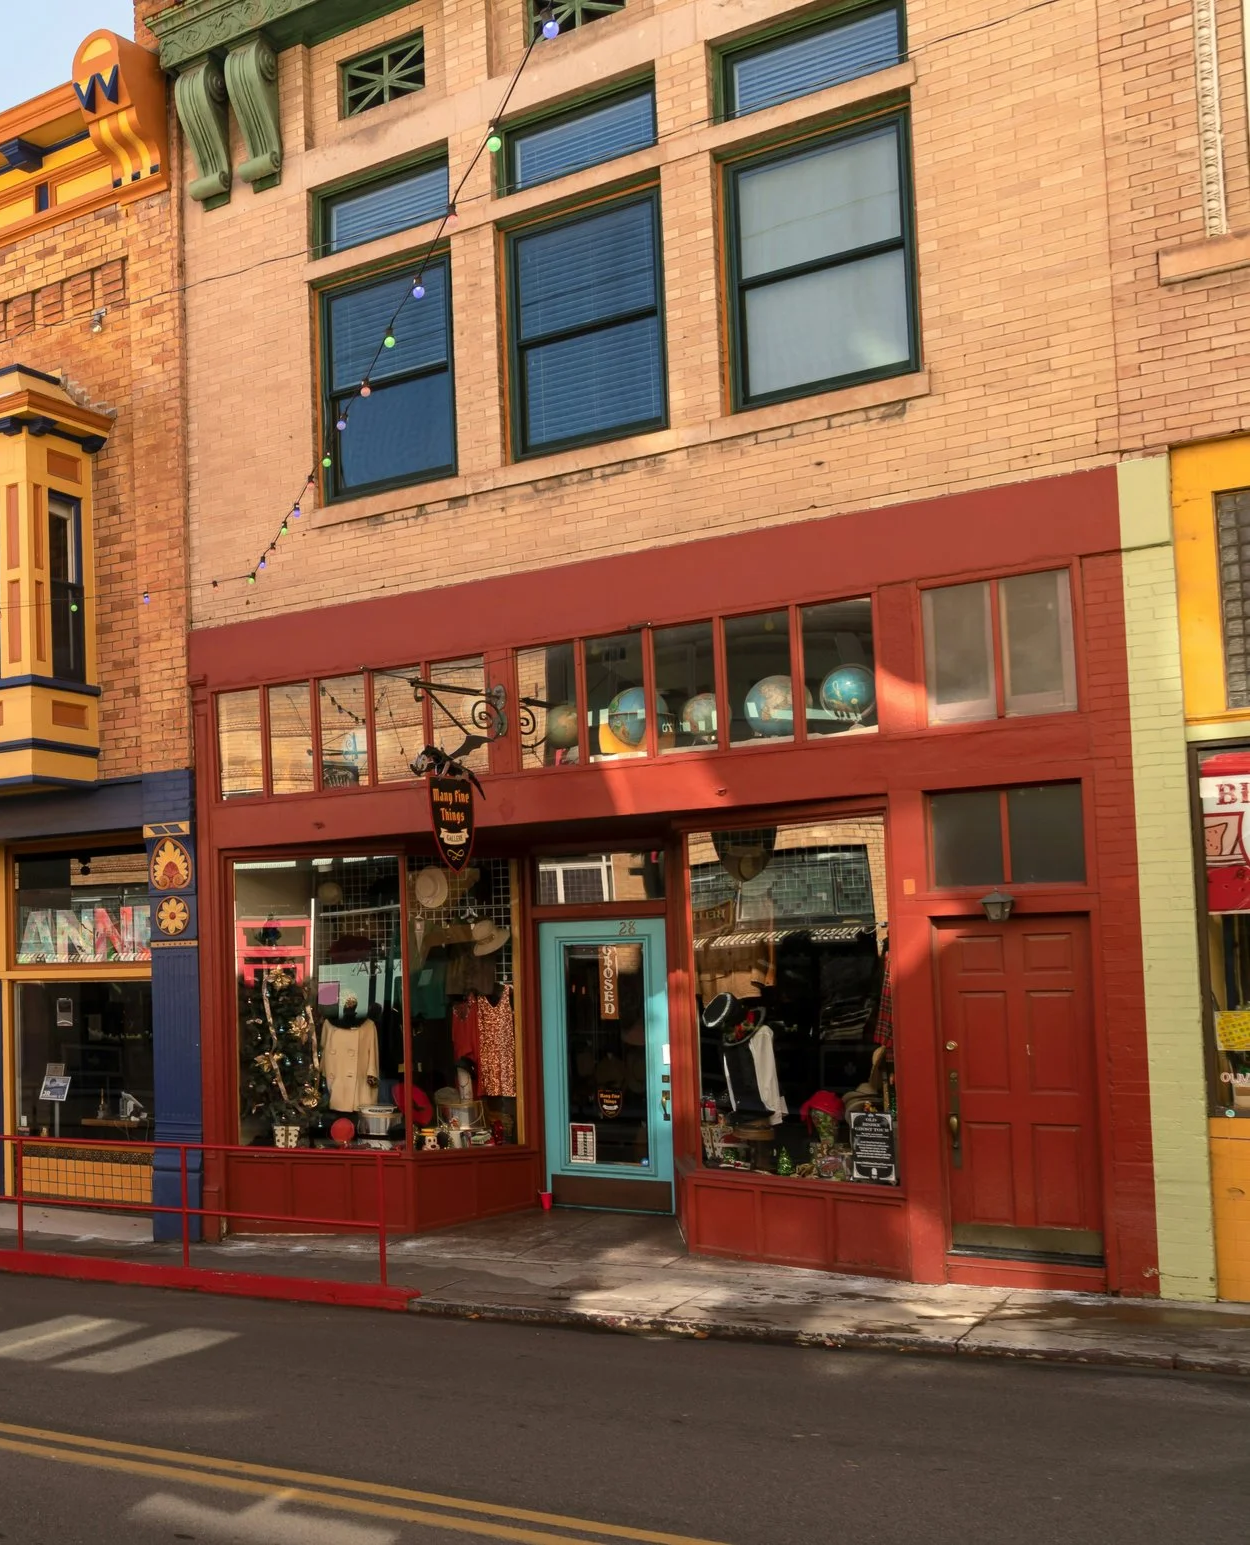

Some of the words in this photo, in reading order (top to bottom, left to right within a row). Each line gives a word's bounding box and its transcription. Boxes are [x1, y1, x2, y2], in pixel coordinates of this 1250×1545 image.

[432, 788, 453, 804] Many
[440, 807, 465, 824] Things
[618, 921, 636, 936] 28
